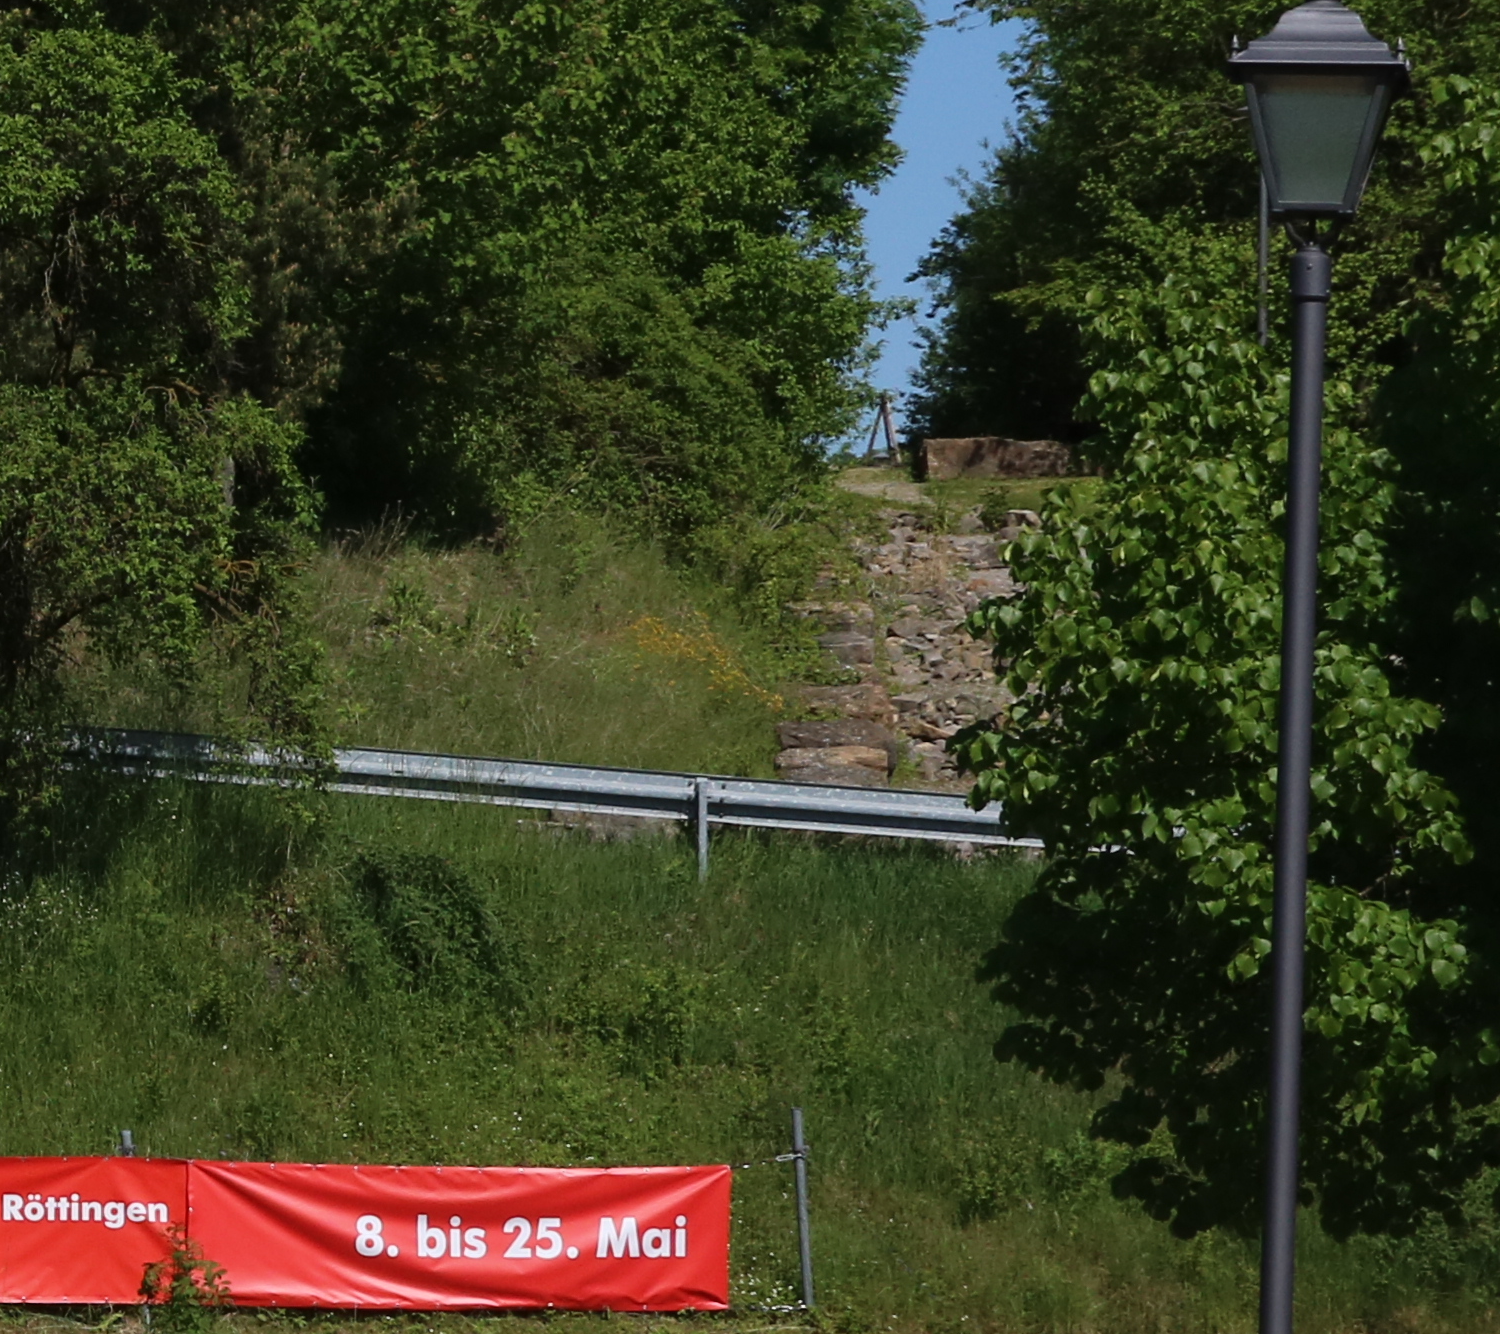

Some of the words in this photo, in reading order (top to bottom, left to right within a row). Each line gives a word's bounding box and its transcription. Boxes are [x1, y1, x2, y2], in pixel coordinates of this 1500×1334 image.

[2, 1193, 169, 1228] Röttingen
[355, 1214, 399, 1258] 8.
[416, 1214, 487, 1259] bis
[502, 1216, 580, 1259] 25.
[596, 1215, 688, 1258] Mai
